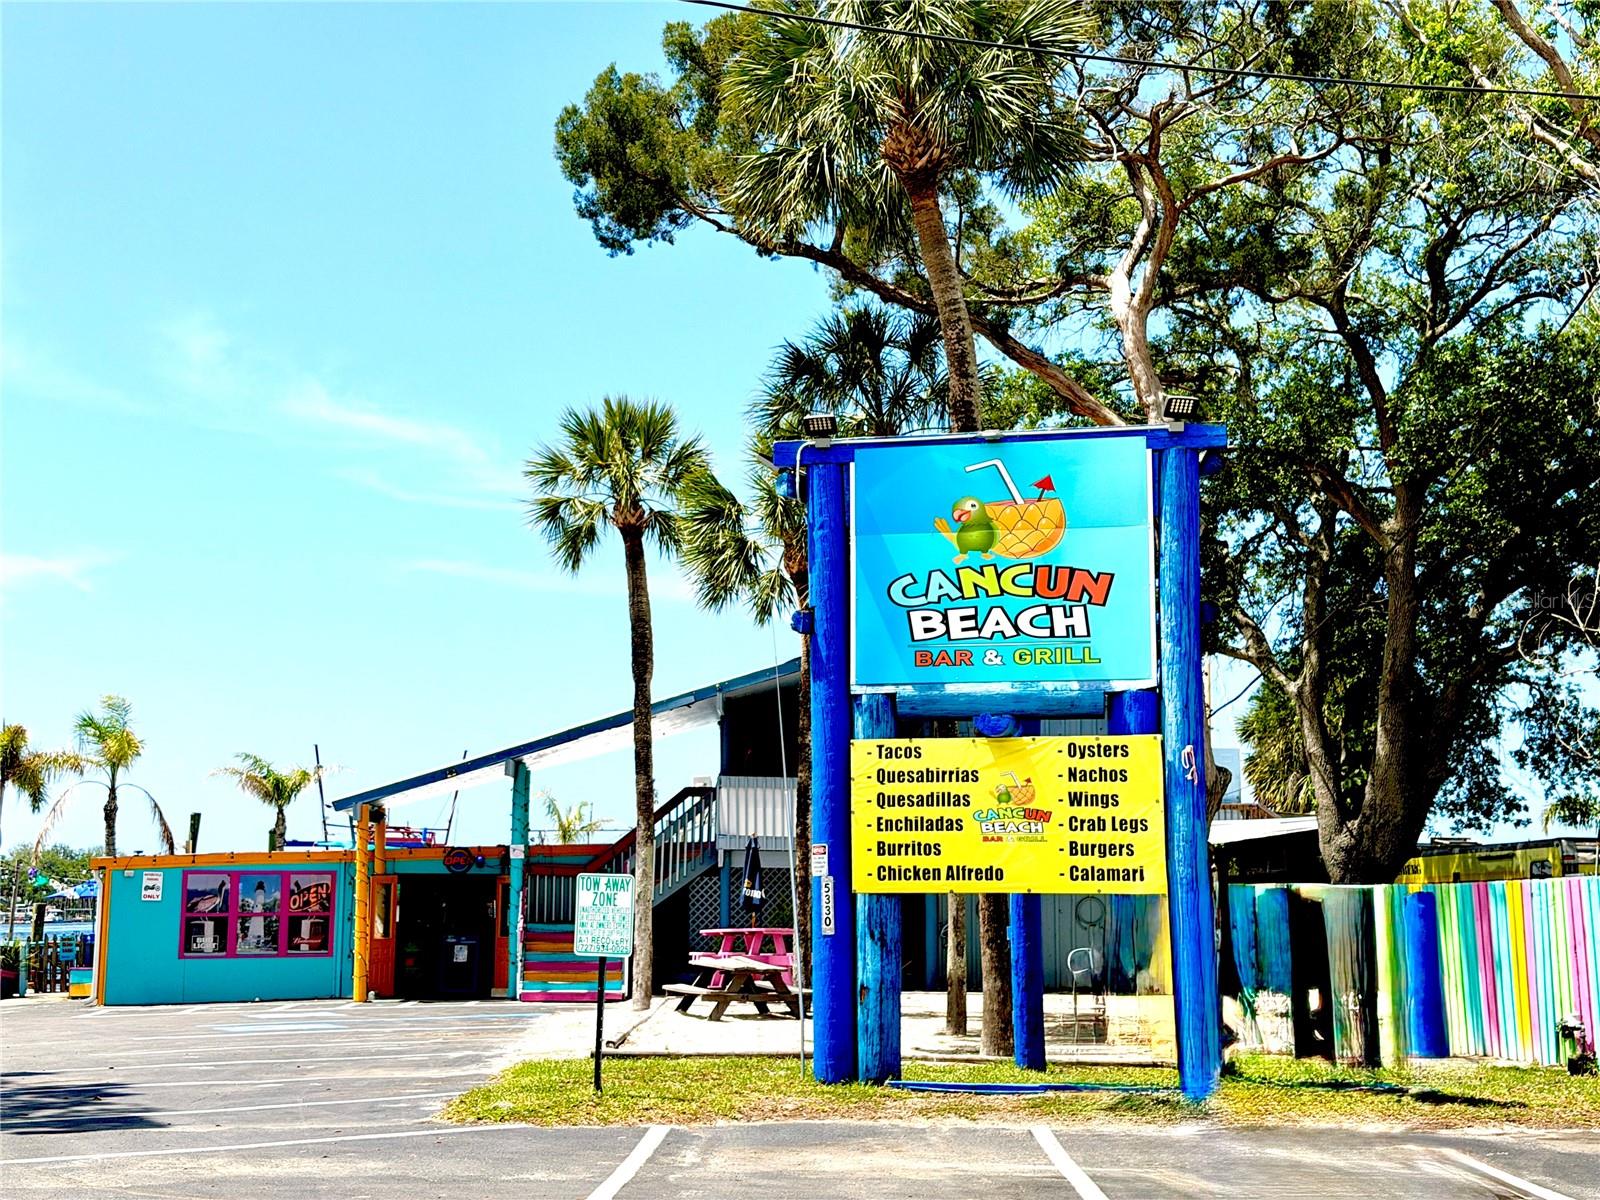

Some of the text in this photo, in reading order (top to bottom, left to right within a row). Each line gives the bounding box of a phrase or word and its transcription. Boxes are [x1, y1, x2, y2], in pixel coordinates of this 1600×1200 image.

[887, 563, 1115, 607] CANCUN
[907, 605, 1091, 641] BEACH
[914, 647, 1101, 667] BAR & GRILL
[876, 744, 922, 760] Tacos
[1067, 742, 1129, 760] Oysters
[876, 767, 979, 785] Quesabirrias
[1068, 766, 1128, 783] Nachos
[876, 791, 971, 808] Quesadillas
[1068, 791, 1120, 809] Wings
[876, 815, 964, 832] Enchiladas
[973, 807, 1052, 823] CANCUN
[980, 821, 1044, 833] BEACH
[1068, 816, 1149, 834] Crab Legs
[876, 840, 942, 857] Burritos
[1069, 840, 1135, 859] Burgers
[877, 865, 1004, 882] Chicken Alfredo
[1069, 865, 1145, 882] Calamari
[581, 877, 631, 892] TOW AWAY
[290, 884, 327, 909] OPEN
[592, 892, 618, 907] ZONE
[824, 883, 832, 927] 5330
